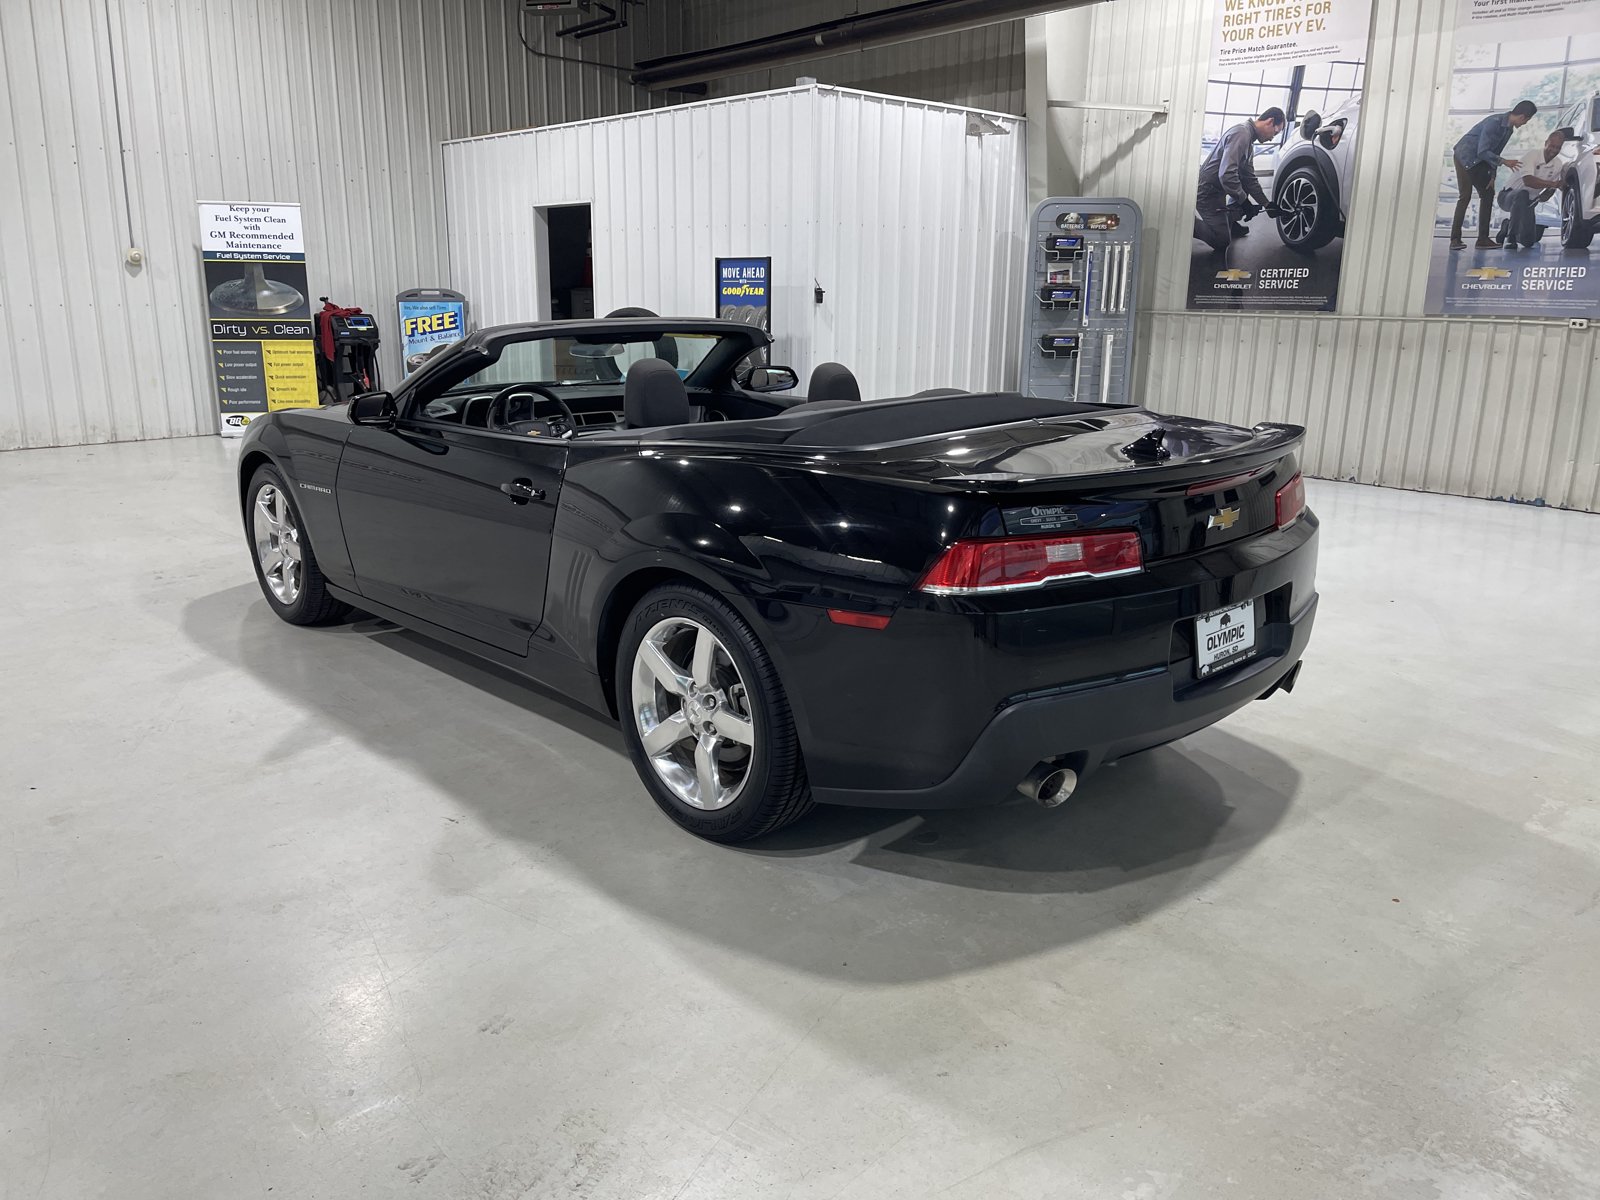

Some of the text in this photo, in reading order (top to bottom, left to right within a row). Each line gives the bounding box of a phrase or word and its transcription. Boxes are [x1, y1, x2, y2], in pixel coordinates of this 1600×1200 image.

[1225, 0, 1244, 11] WE
[1223, 2, 1331, 27] RIGHT TIRES FOR
[1222, 18, 1326, 42] YOUR CHEVY EV.
[1266, 42, 1298, 51] Guarantee.
[229, 205, 250, 214] Keep
[234, 215, 262, 224] System
[229, 231, 294, 240] Recommended
[226, 241, 282, 249] Maintenance
[722, 267, 765, 279] MOVE AHEAD
[1260, 268, 1309, 278] CERTIFIED
[1523, 266, 1586, 278] CERTIFIED
[1258, 279, 1299, 289] SERVICE
[1521, 279, 1574, 291] SERVICE
[722, 286, 764, 296] GOODYEAR
[405, 311, 458, 336] FREE
[213, 324, 247, 336] Dirty
[274, 324, 310, 334] Clean
[300, 483, 331, 494] CAMARO
[1031, 506, 1064, 516] OLYMPIC
[1207, 624, 1244, 651] OLYMPIC
[1232, 645, 1238, 654] SD
